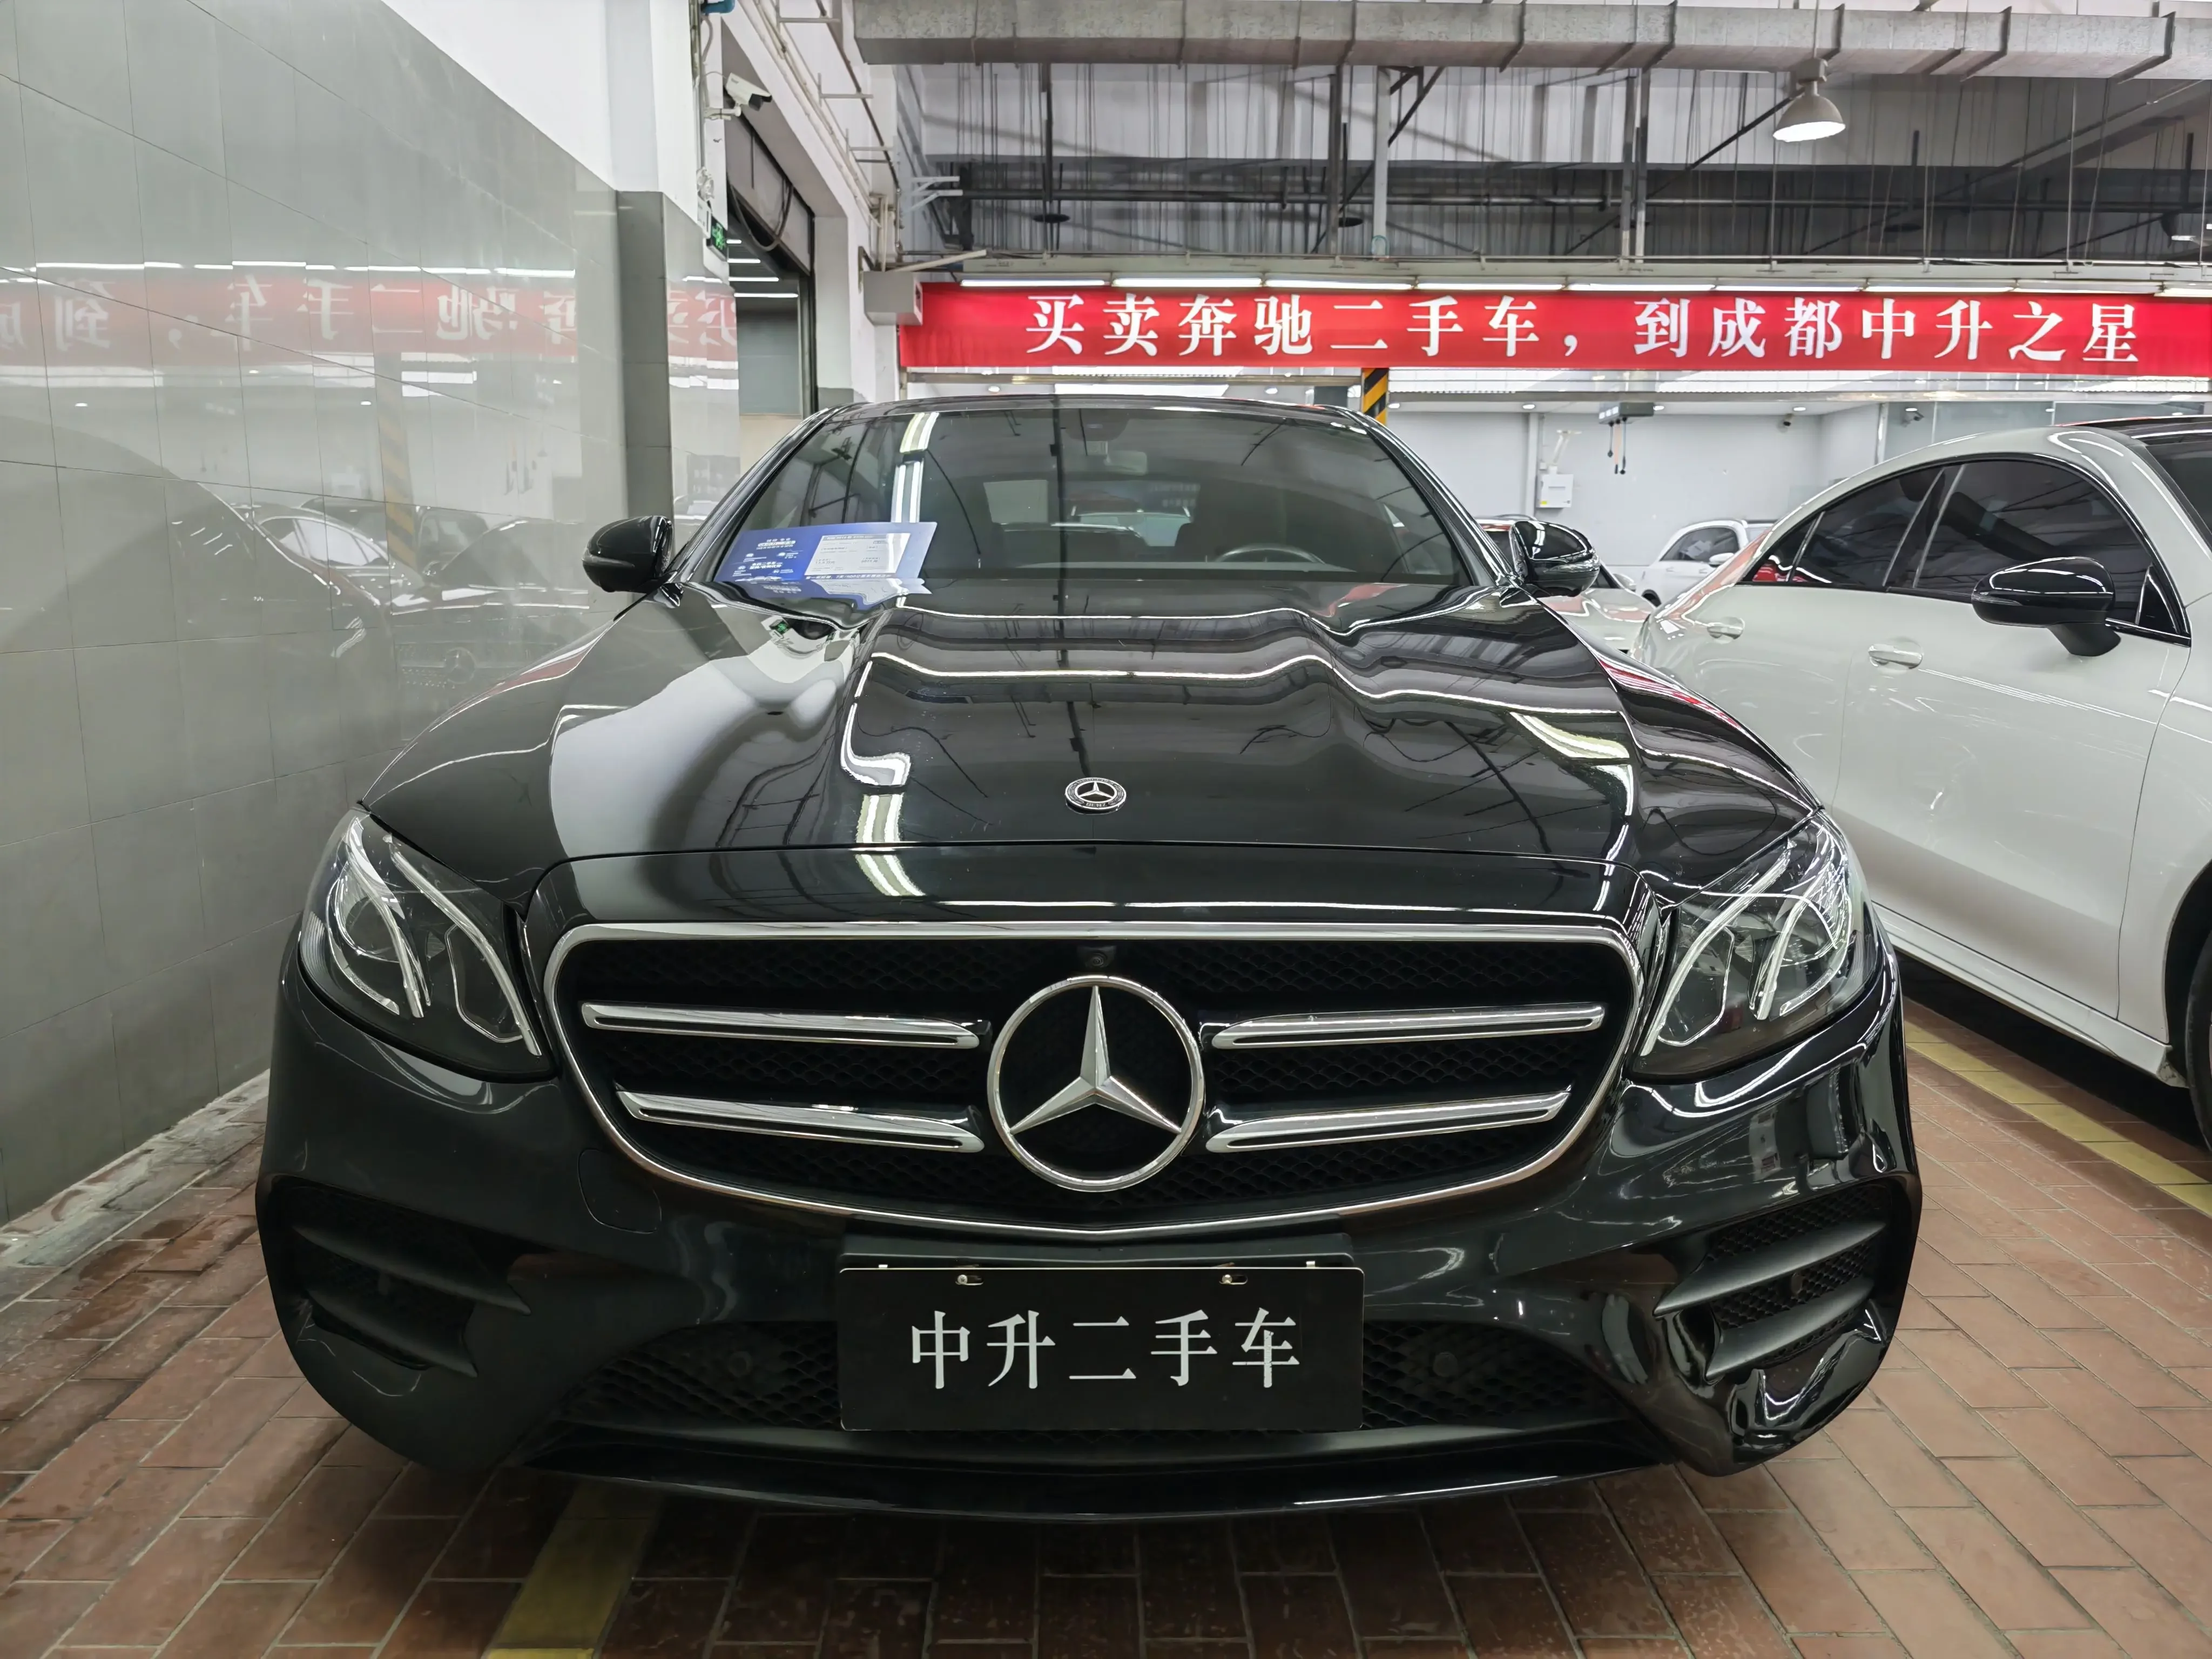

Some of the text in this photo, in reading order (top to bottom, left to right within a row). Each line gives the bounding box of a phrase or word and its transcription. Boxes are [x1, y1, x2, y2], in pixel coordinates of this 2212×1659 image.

[1025, 293, 2139, 362] 买卖奔驰二手车，到成都中升之星
[911, 1306, 1300, 1390] 中升二手车
